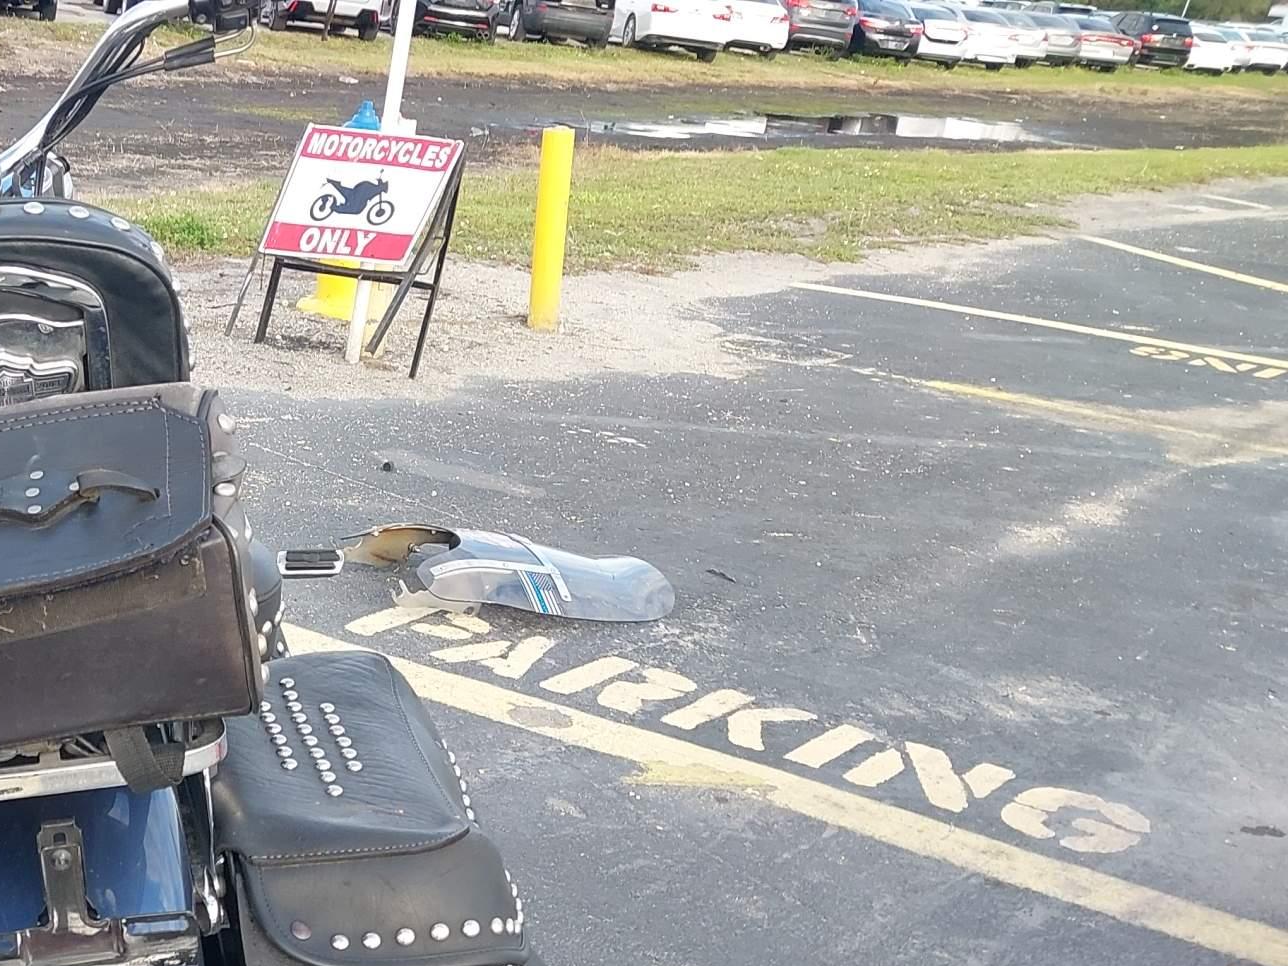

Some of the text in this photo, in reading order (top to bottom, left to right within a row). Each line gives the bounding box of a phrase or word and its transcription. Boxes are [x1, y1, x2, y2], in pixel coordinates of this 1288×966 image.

[307, 133, 453, 168] MOTORCYCLES
[299, 227, 376, 255] ONLY
[344, 605, 1152, 854] PARKING
